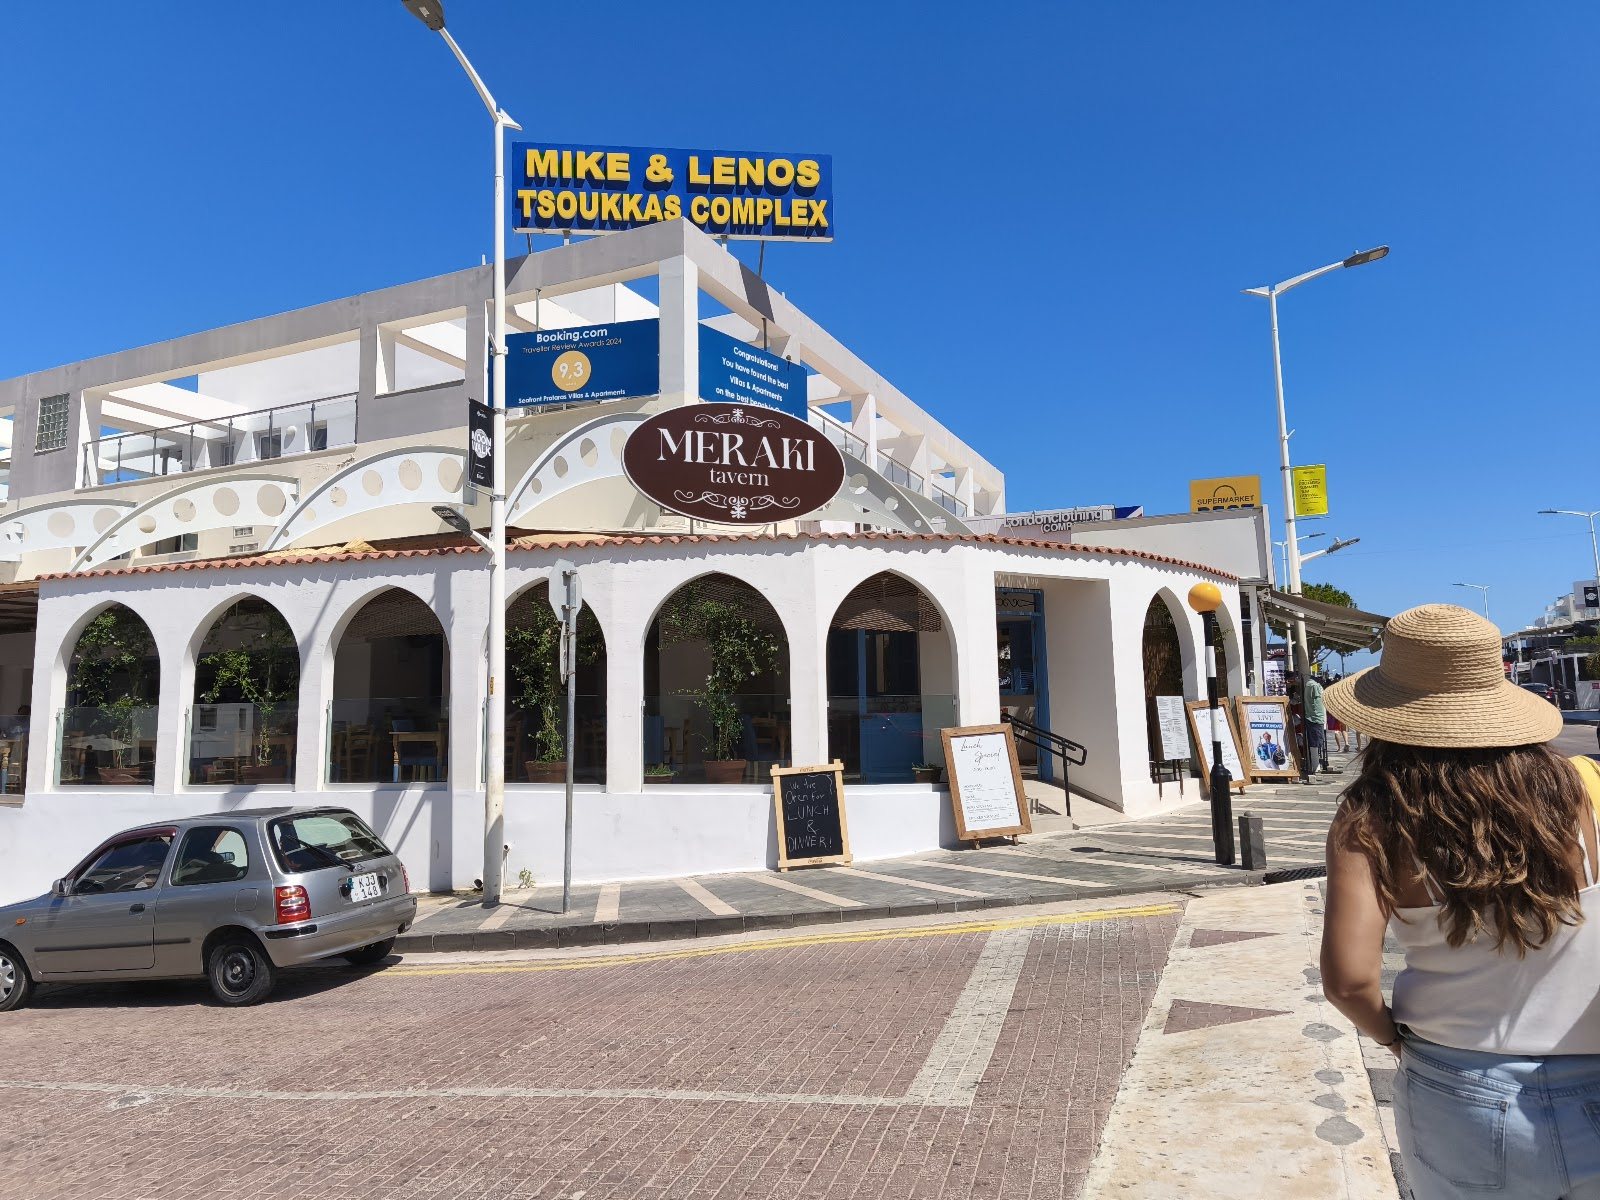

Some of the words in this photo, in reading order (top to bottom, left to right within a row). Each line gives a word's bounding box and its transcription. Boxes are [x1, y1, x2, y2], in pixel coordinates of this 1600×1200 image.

[526, 148, 630, 183] MIKE
[645, 153, 675, 184] &
[689, 156, 820, 188] LENOS
[517, 189, 682, 222] TSOUKKAS
[690, 196, 829, 228] COMPLEX
[536, 328, 608, 343] Booking.com
[522, 345, 550, 354] Traveller
[551, 342, 577, 351] Review
[578, 339, 605, 348] Awards
[606, 338, 622, 346] 2024
[733, 346, 779, 372] Congratulations!
[722, 357, 734, 368] You
[735, 362, 750, 375] have
[751, 368, 767, 381] found
[767, 375, 777, 385] the
[777, 379, 789, 390] best
[518, 396, 542, 404] Seafront
[543, 394, 567, 402] Protaras
[591, 389, 625, 399] Apartments
[715, 387, 724, 396] on
[725, 388, 735, 399] the
[736, 393, 749, 404] best
[730, 375, 746, 388] Villas
[746, 381, 751, 390] &
[752, 384, 783, 402] Apartments
[472, 430, 491, 447] MOON
[472, 440, 491, 457] WALK
[657, 428, 815, 471] MERAKI
[709, 467, 769, 487] tavern
[1197, 494, 1254, 506] SUPERMARKET
[1003, 509, 1103, 528] Londonclothing
[1041, 521, 1073, 534] (COMP
[790, 781, 800, 790] We
[788, 805, 829, 820] LUNCH
[807, 819, 820, 834] &
[788, 835, 832, 852] DINNER!
[361, 886, 379, 898] 148
